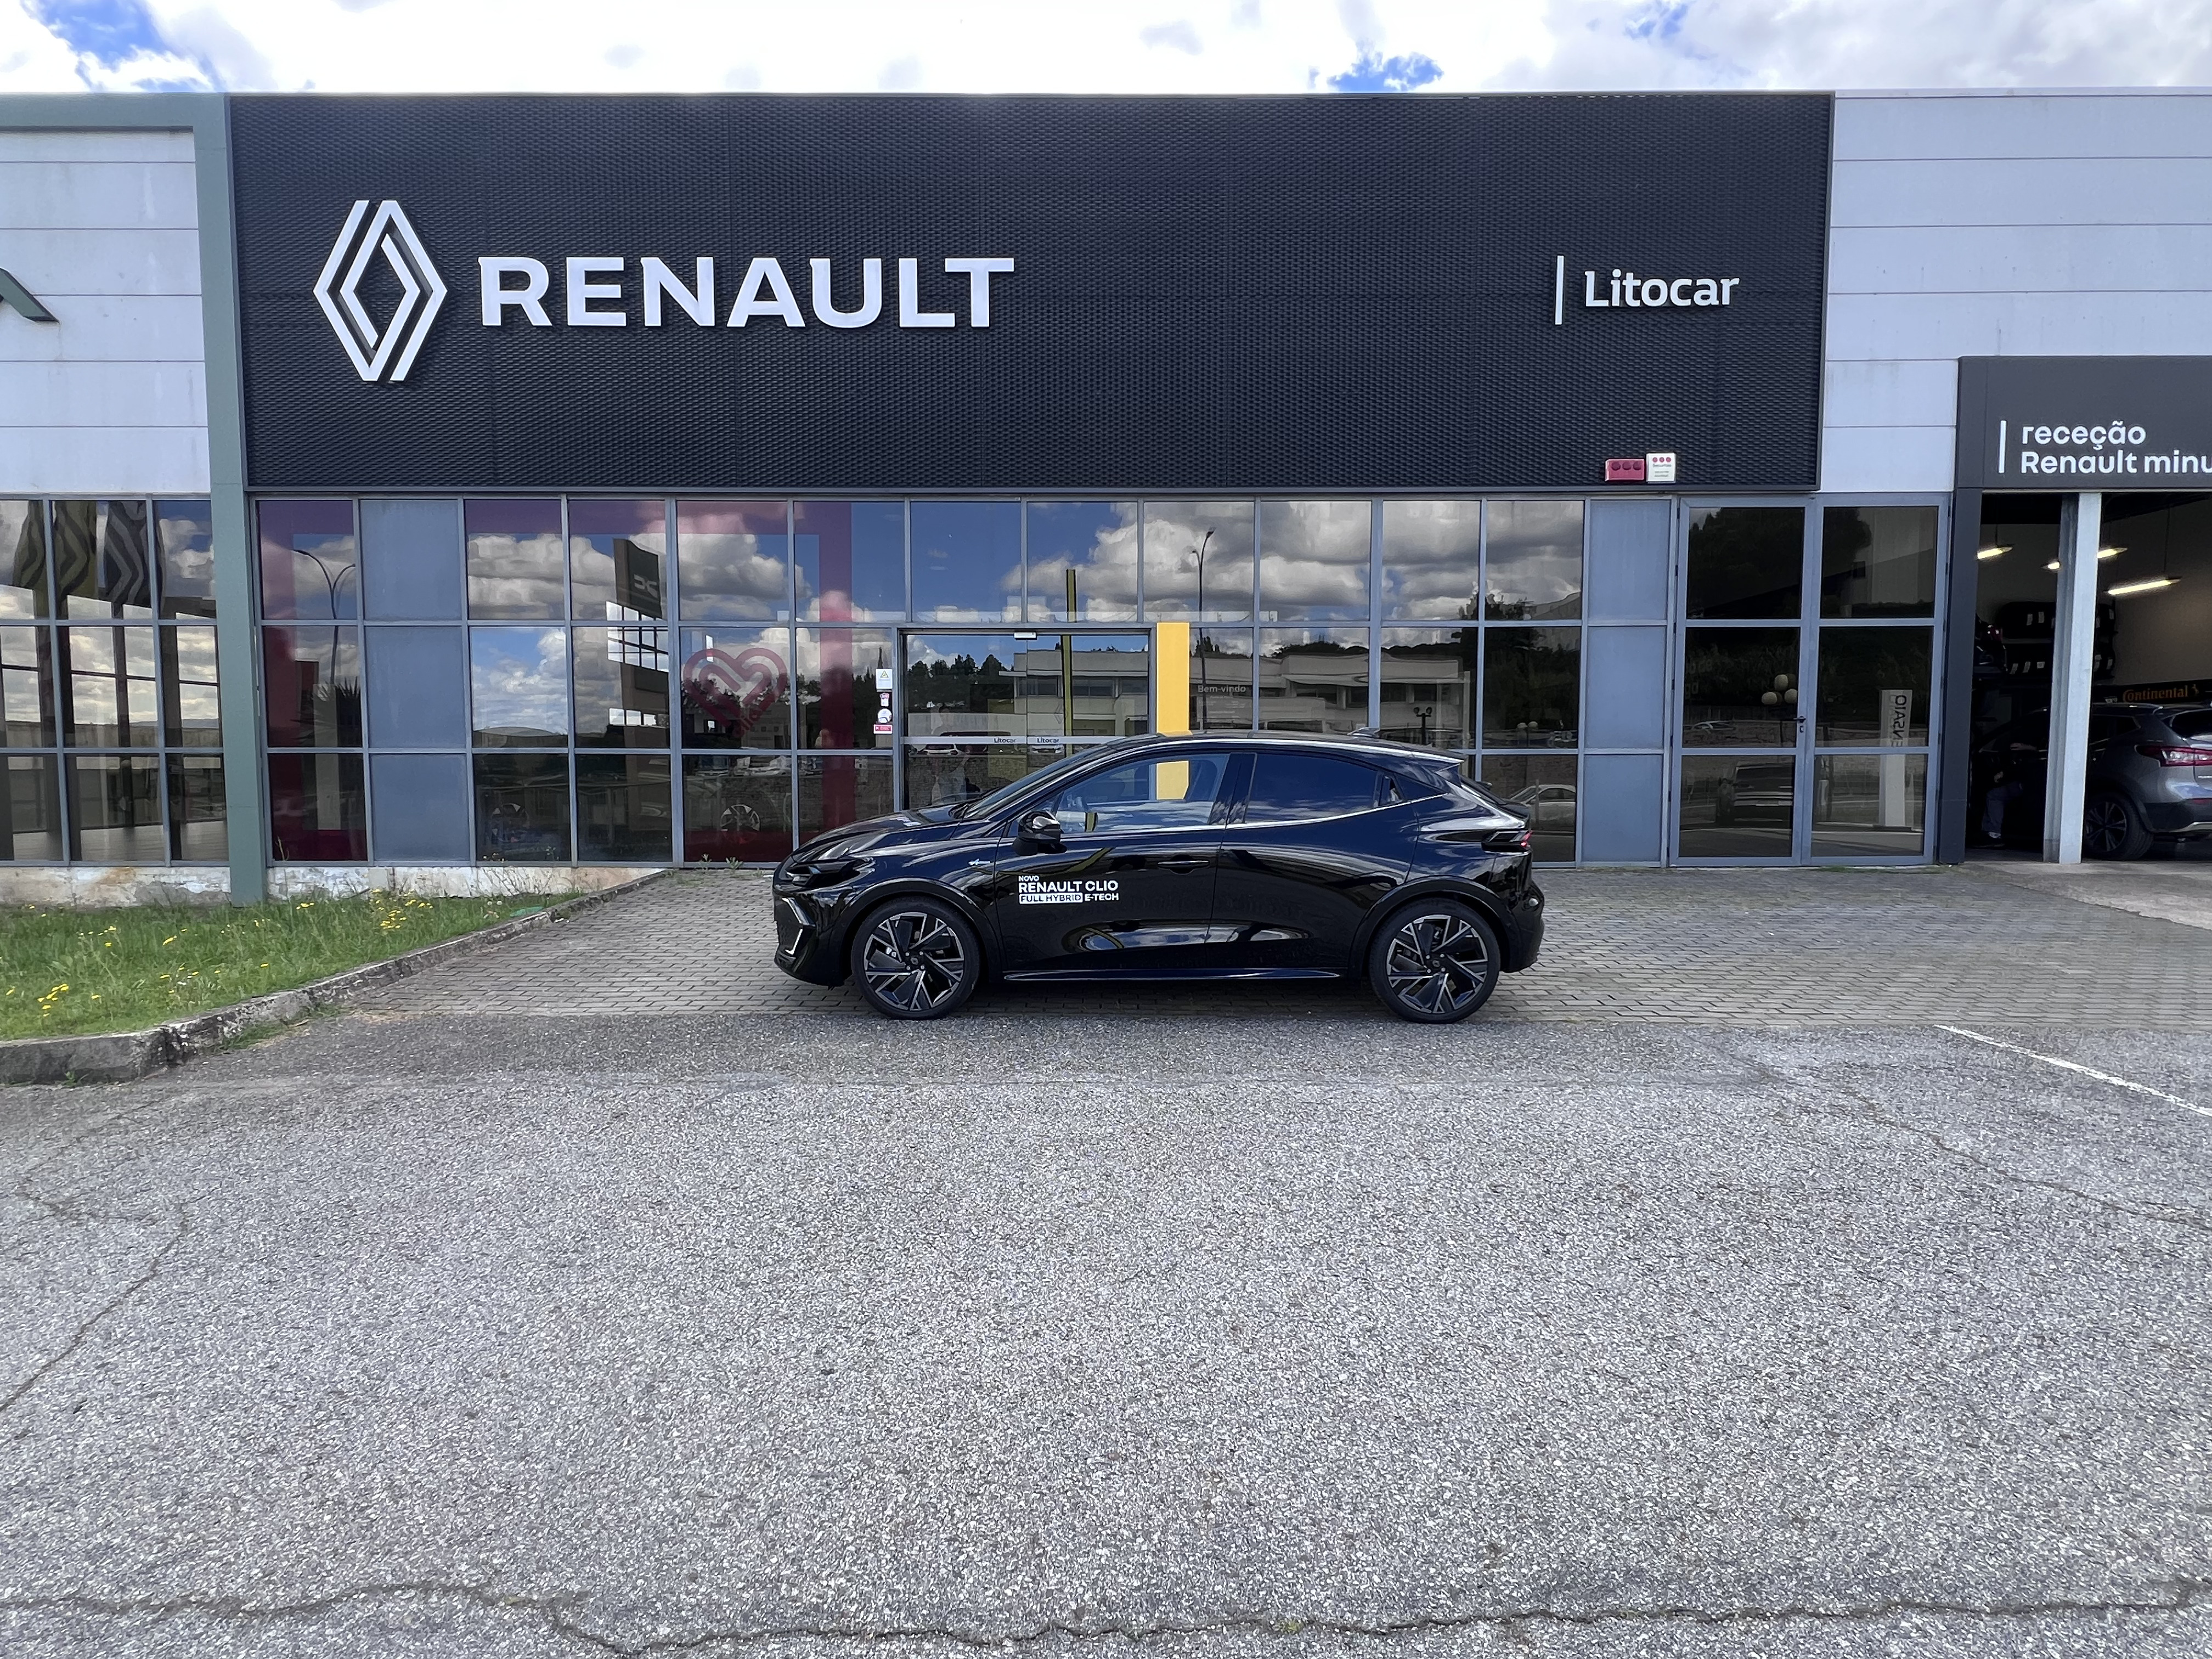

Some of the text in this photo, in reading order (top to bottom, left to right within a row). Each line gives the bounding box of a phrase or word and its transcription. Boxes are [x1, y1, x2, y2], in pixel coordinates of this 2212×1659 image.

[478, 256, 1015, 328] RENAULT
[1584, 269, 1740, 307] Litocar
[2021, 420, 2146, 450] receção
[2021, 450, 2212, 473] Renault minu
[1198, 685, 1246, 693] Bem-vindo
[2123, 685, 2188, 703] Continental
[1018, 880, 1119, 893] RENAULT CLIO
[1020, 894, 1044, 902] FULL
[1084, 893, 1119, 901] E-TECH
